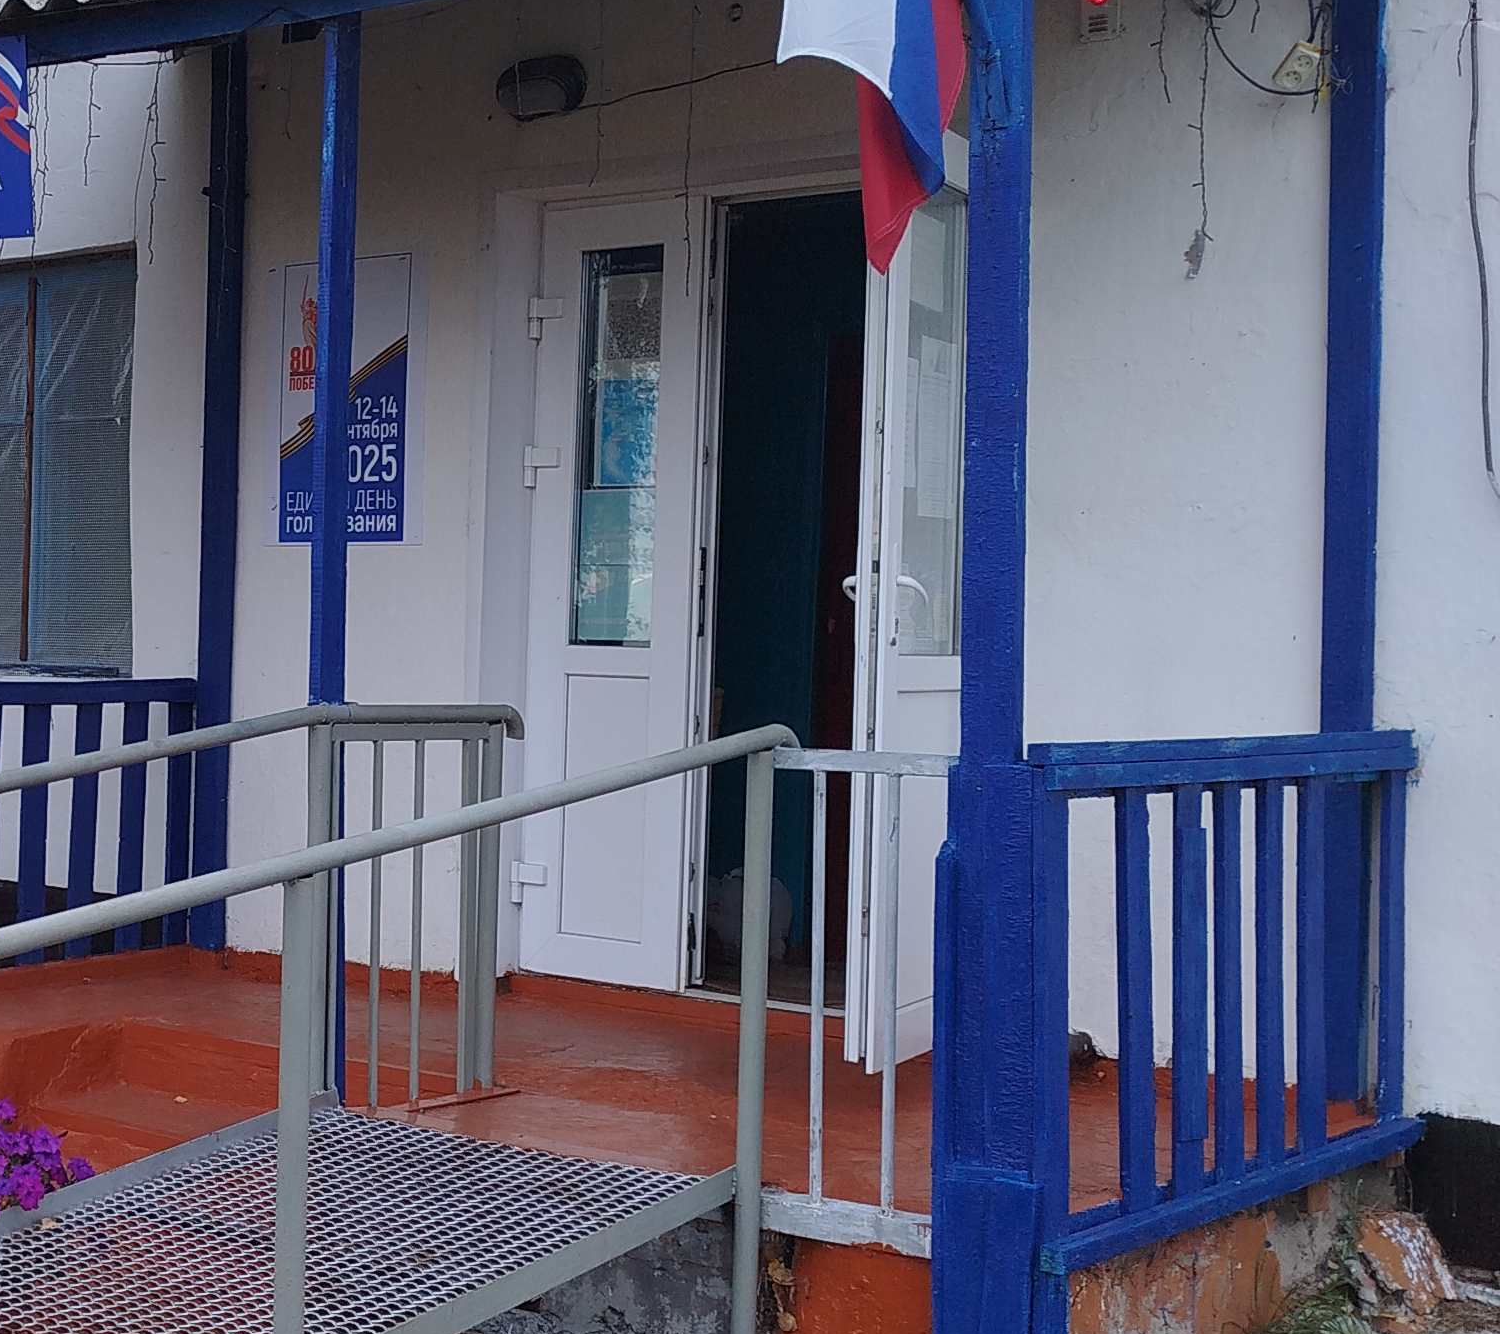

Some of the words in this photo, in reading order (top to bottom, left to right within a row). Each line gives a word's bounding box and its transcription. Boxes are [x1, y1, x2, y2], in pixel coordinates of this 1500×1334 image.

[290, 346, 314, 373] 80
[289, 377, 315, 391] ПОБЕ
[355, 396, 398, 420] 12-14
[347, 419, 398, 442] нтября
[348, 444, 397, 483] 025
[354, 489, 397, 512] ДЕНЬ
